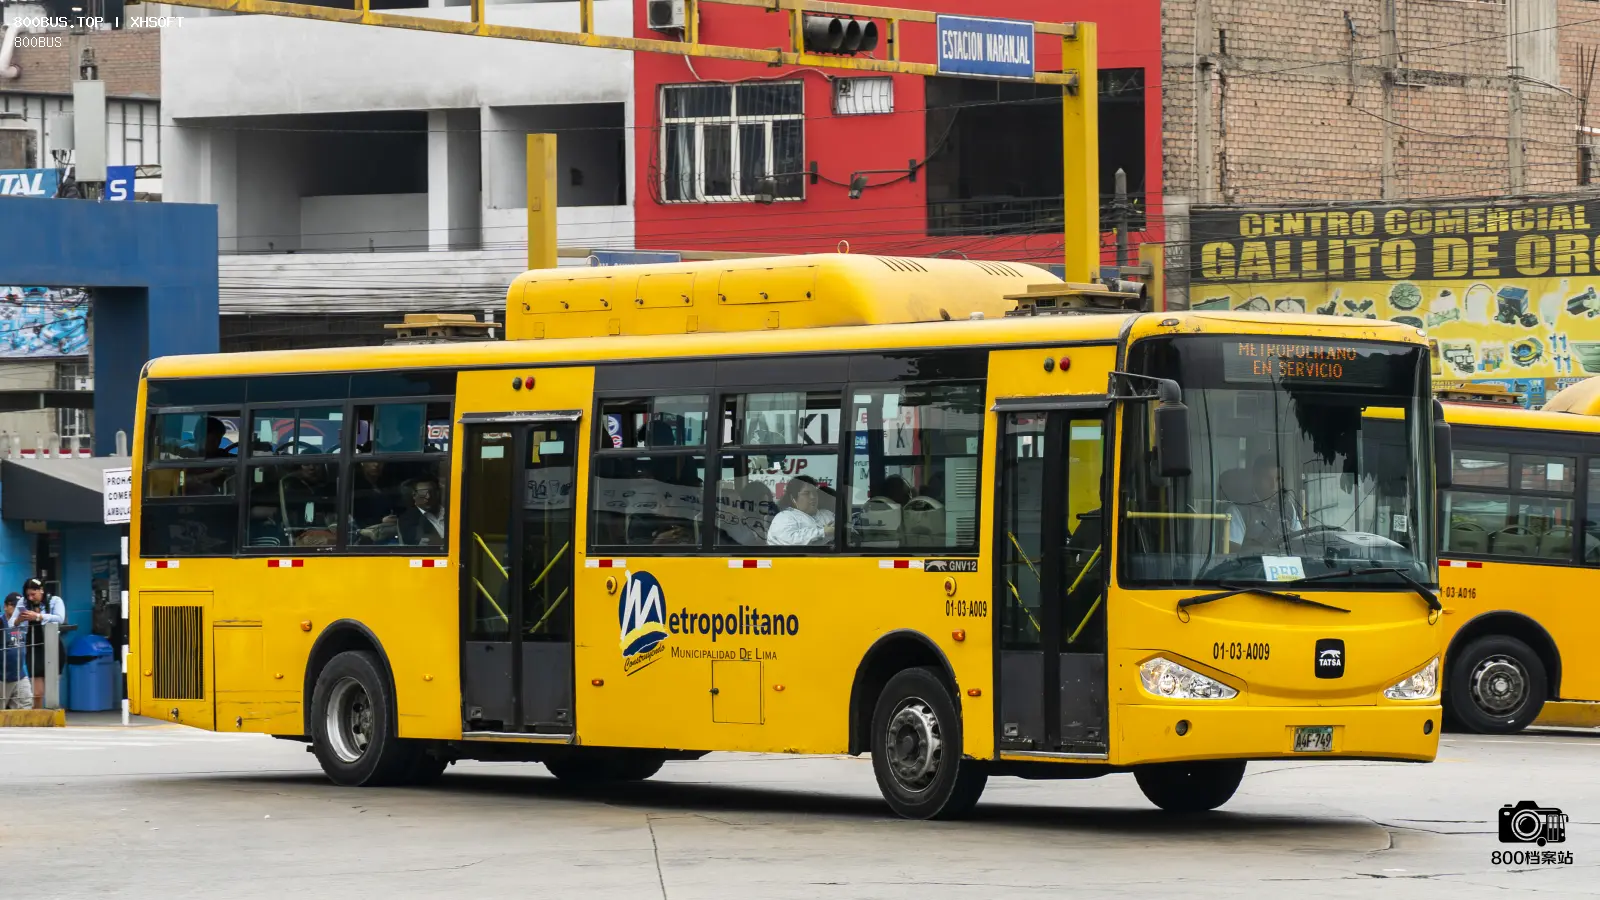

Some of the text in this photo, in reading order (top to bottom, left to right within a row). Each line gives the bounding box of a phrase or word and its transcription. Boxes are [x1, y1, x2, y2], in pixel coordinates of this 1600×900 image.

[942, 30, 1030, 65] ESTACION NARANJAL
[1239, 204, 1591, 238] CENTRO COMERCIAL
[1201, 233, 1600, 281] GALLITO DE OR
[1253, 360, 1343, 379] EN SERVICIO
[949, 561, 977, 571] GNV12
[945, 599, 988, 618] 01-03-A009
[1212, 641, 1271, 661] 01-03-A009
[1318, 658, 1342, 667] TATSA
[1296, 733, 1332, 748] A4F-749
